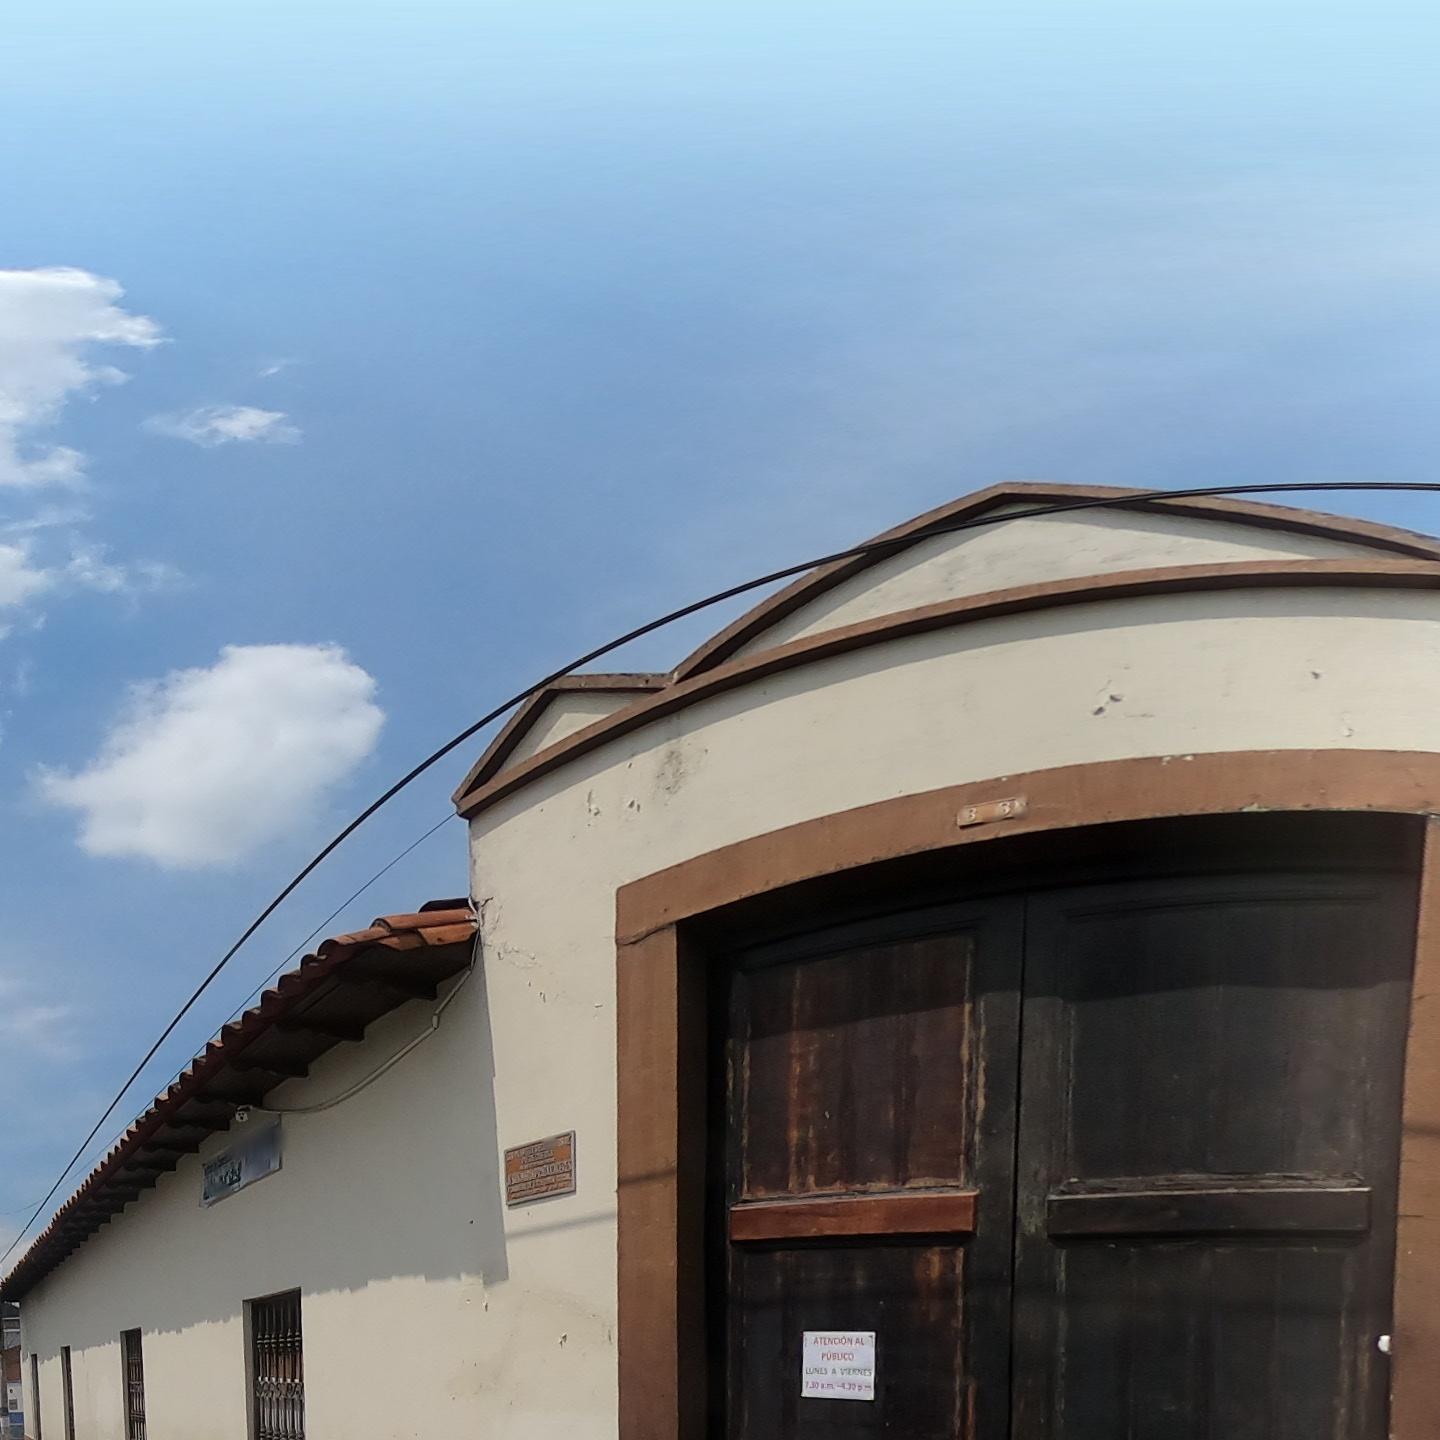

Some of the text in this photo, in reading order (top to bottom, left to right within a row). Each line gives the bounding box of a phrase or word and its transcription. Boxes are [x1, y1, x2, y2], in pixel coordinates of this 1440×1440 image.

[813, 1336, 865, 1346] ATENCIÓN AL
[821, 1351, 855, 1361] PÚBLICO
[805, 1367, 828, 1375] LUNES
[840, 1367, 873, 1377] VIERNES
